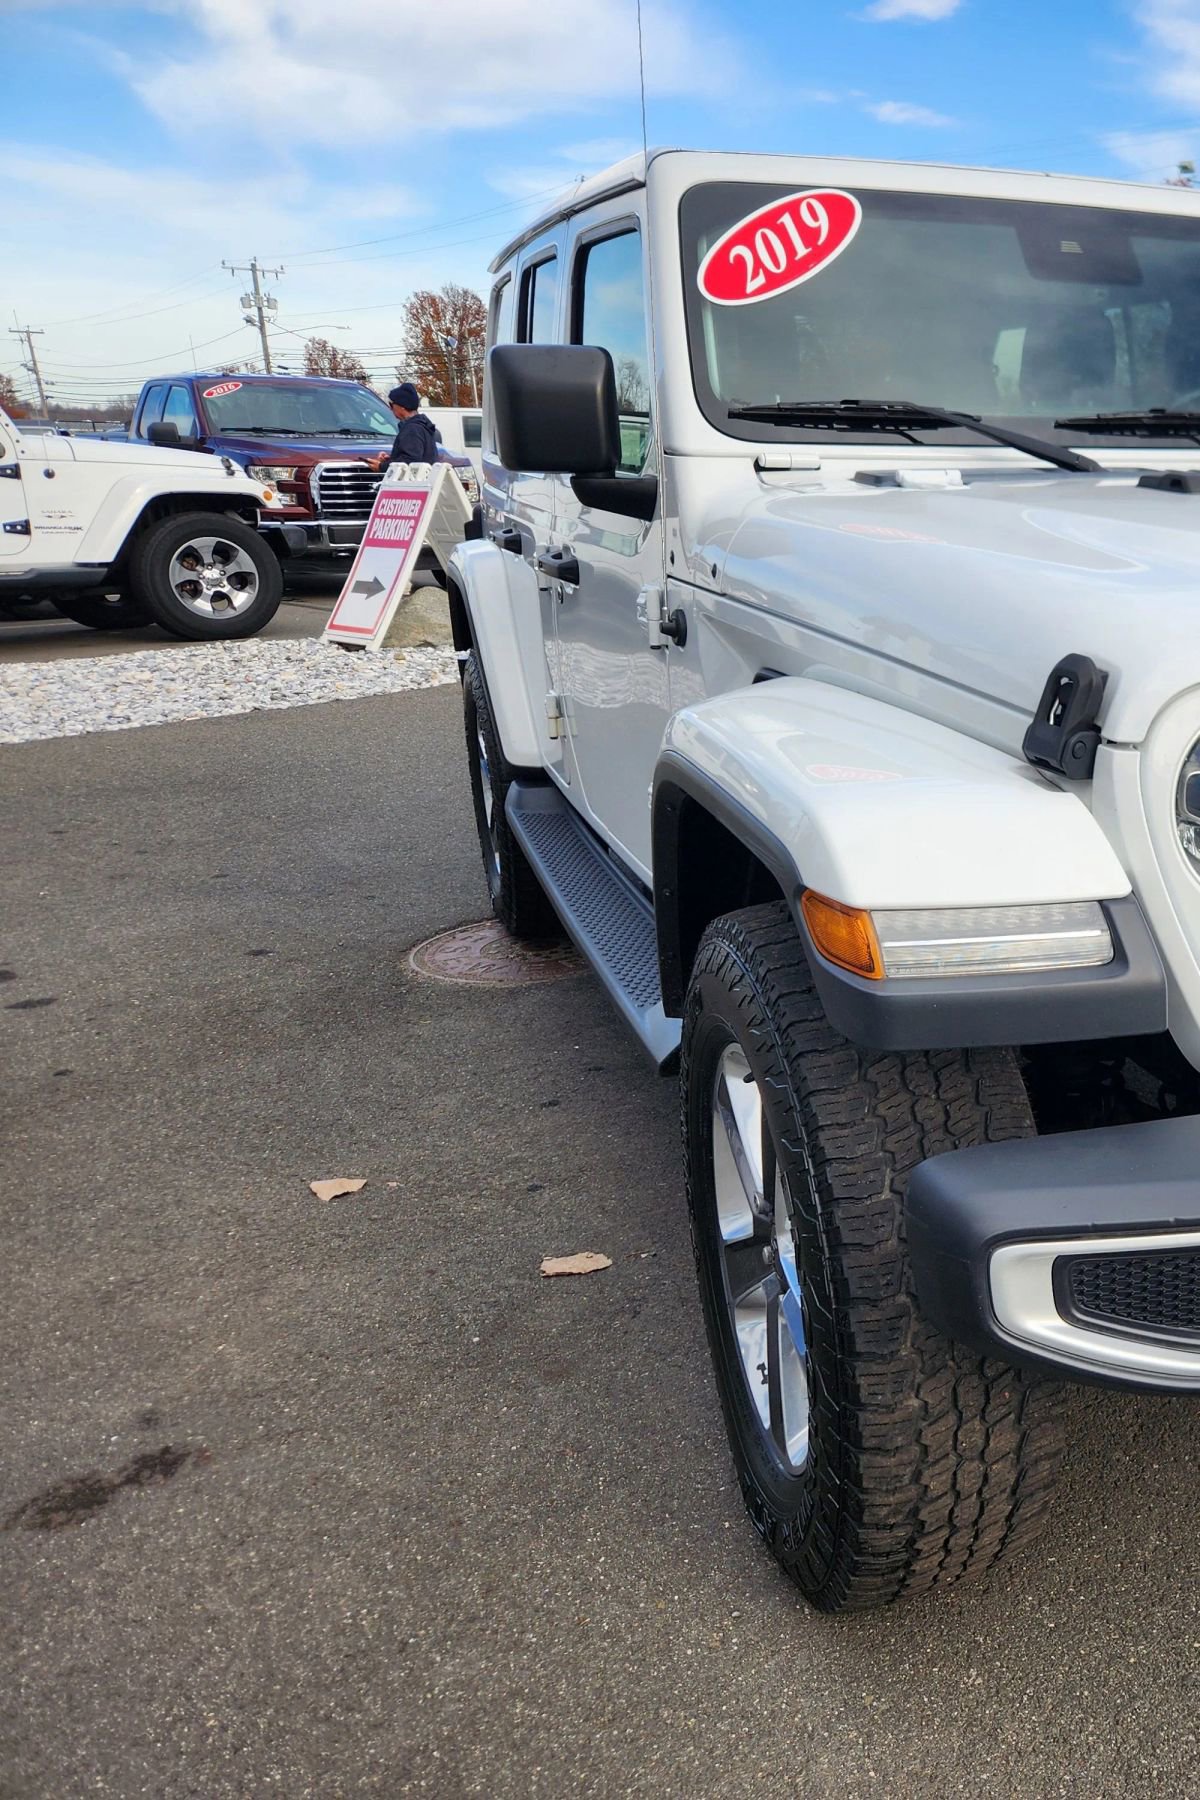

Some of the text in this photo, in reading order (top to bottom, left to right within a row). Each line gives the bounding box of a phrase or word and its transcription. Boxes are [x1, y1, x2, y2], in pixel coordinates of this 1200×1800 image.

[729, 198, 829, 294] 2019
[211, 383, 236, 396] 2016
[378, 498, 421, 516] CUSTOMER
[370, 518, 415, 540] PARKING
